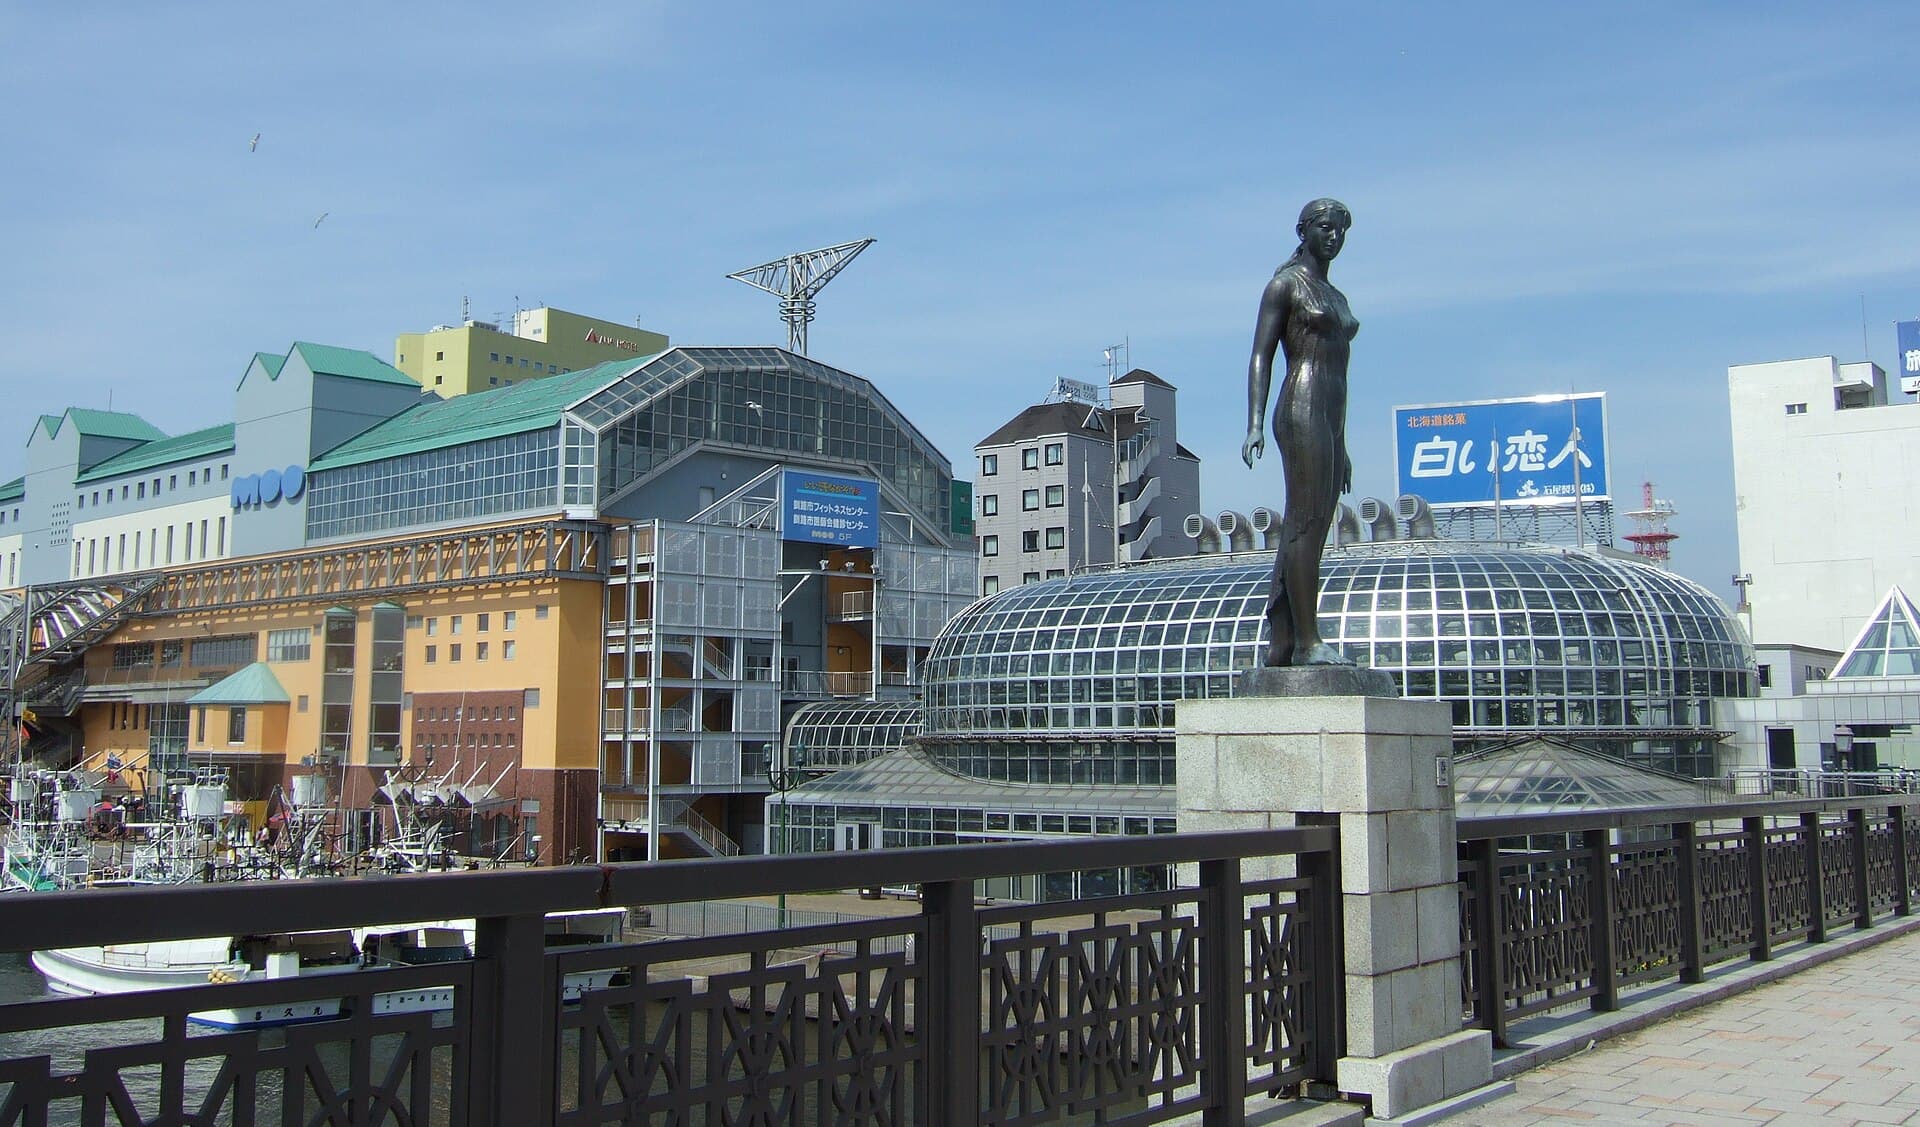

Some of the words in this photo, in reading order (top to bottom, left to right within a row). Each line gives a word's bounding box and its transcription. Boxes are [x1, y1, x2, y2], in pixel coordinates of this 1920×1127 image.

[1407, 413, 1467, 428] 北海道銘菓
[1410, 429, 1592, 478] 白い恋人
